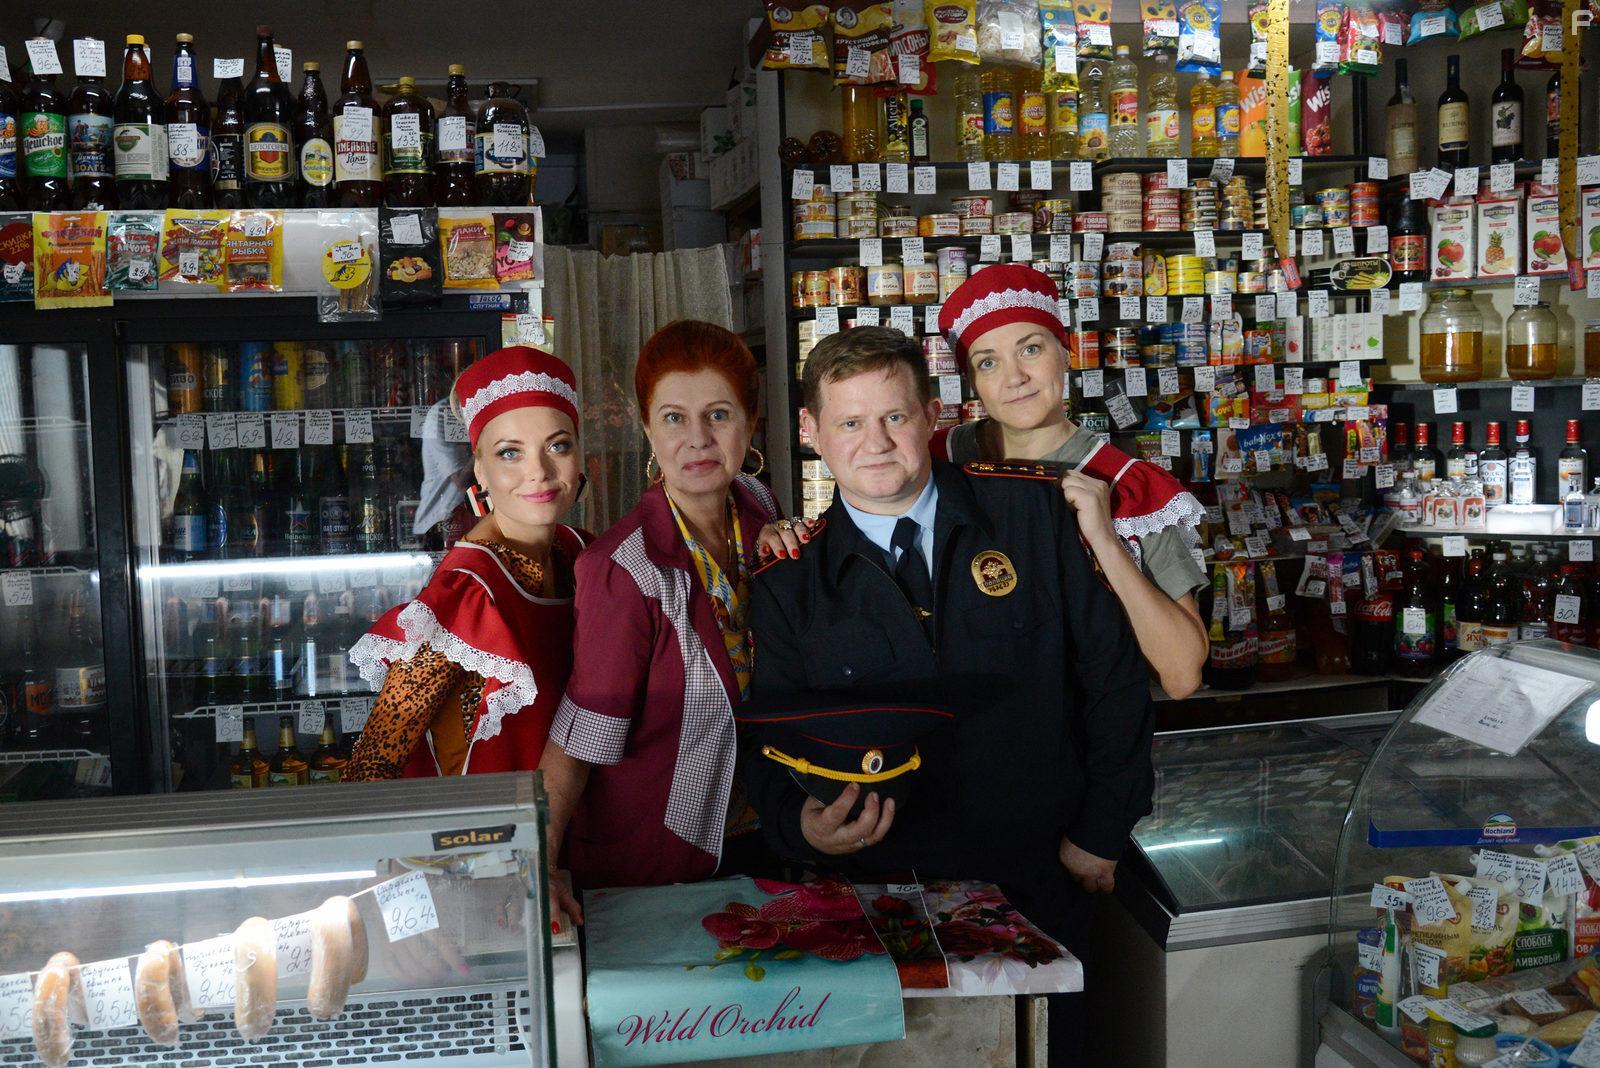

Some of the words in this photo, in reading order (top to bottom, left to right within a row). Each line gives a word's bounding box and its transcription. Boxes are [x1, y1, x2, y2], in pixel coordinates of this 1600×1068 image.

[336, 140, 377, 154] ХМЕЛЬНЫЕ
[226, 239, 274, 248] ЯНТАРНАЯ
[232, 247, 266, 256] РЫБКА
[1485, 826, 1515, 836] Hochland
[439, 831, 504, 846] solar
[617, 1004, 712, 1048] Wild
[709, 985, 832, 1039] Orchid
